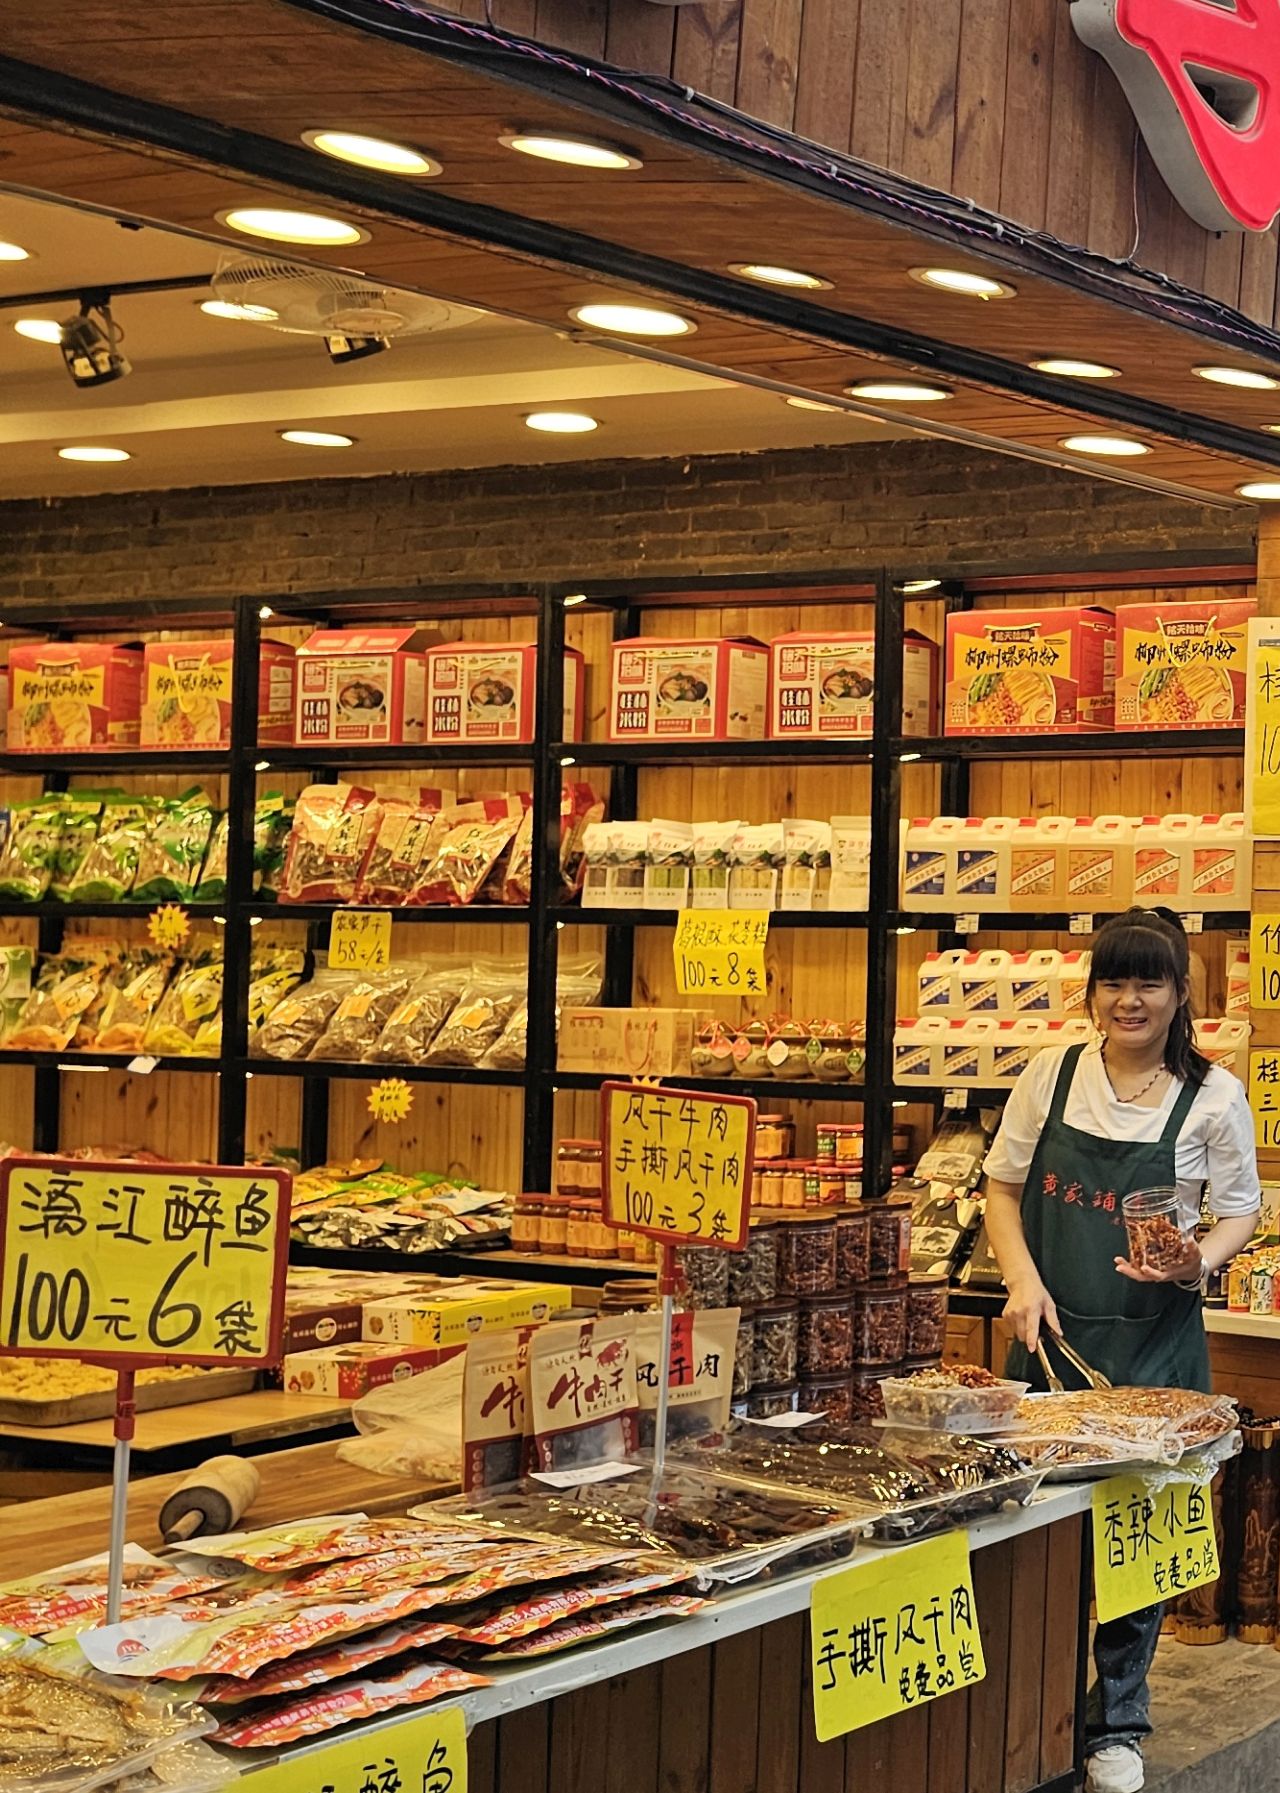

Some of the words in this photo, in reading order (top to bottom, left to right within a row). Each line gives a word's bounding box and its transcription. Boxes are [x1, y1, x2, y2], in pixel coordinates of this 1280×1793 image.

[623, 1094, 729, 1143] 风干牛肉
[614, 1139, 739, 1189] 手撕风干肉
[19, 1169, 271, 1267] 漓江醉鱼
[8, 1251, 262, 1356] 100元6袋
[1104, 1483, 1208, 1568] 香辣小鱼
[1153, 1538, 1217, 1595] 免费品尝
[816, 1584, 972, 1691] 手撕风干肉
[899, 1641, 979, 1704] 免费品尝
